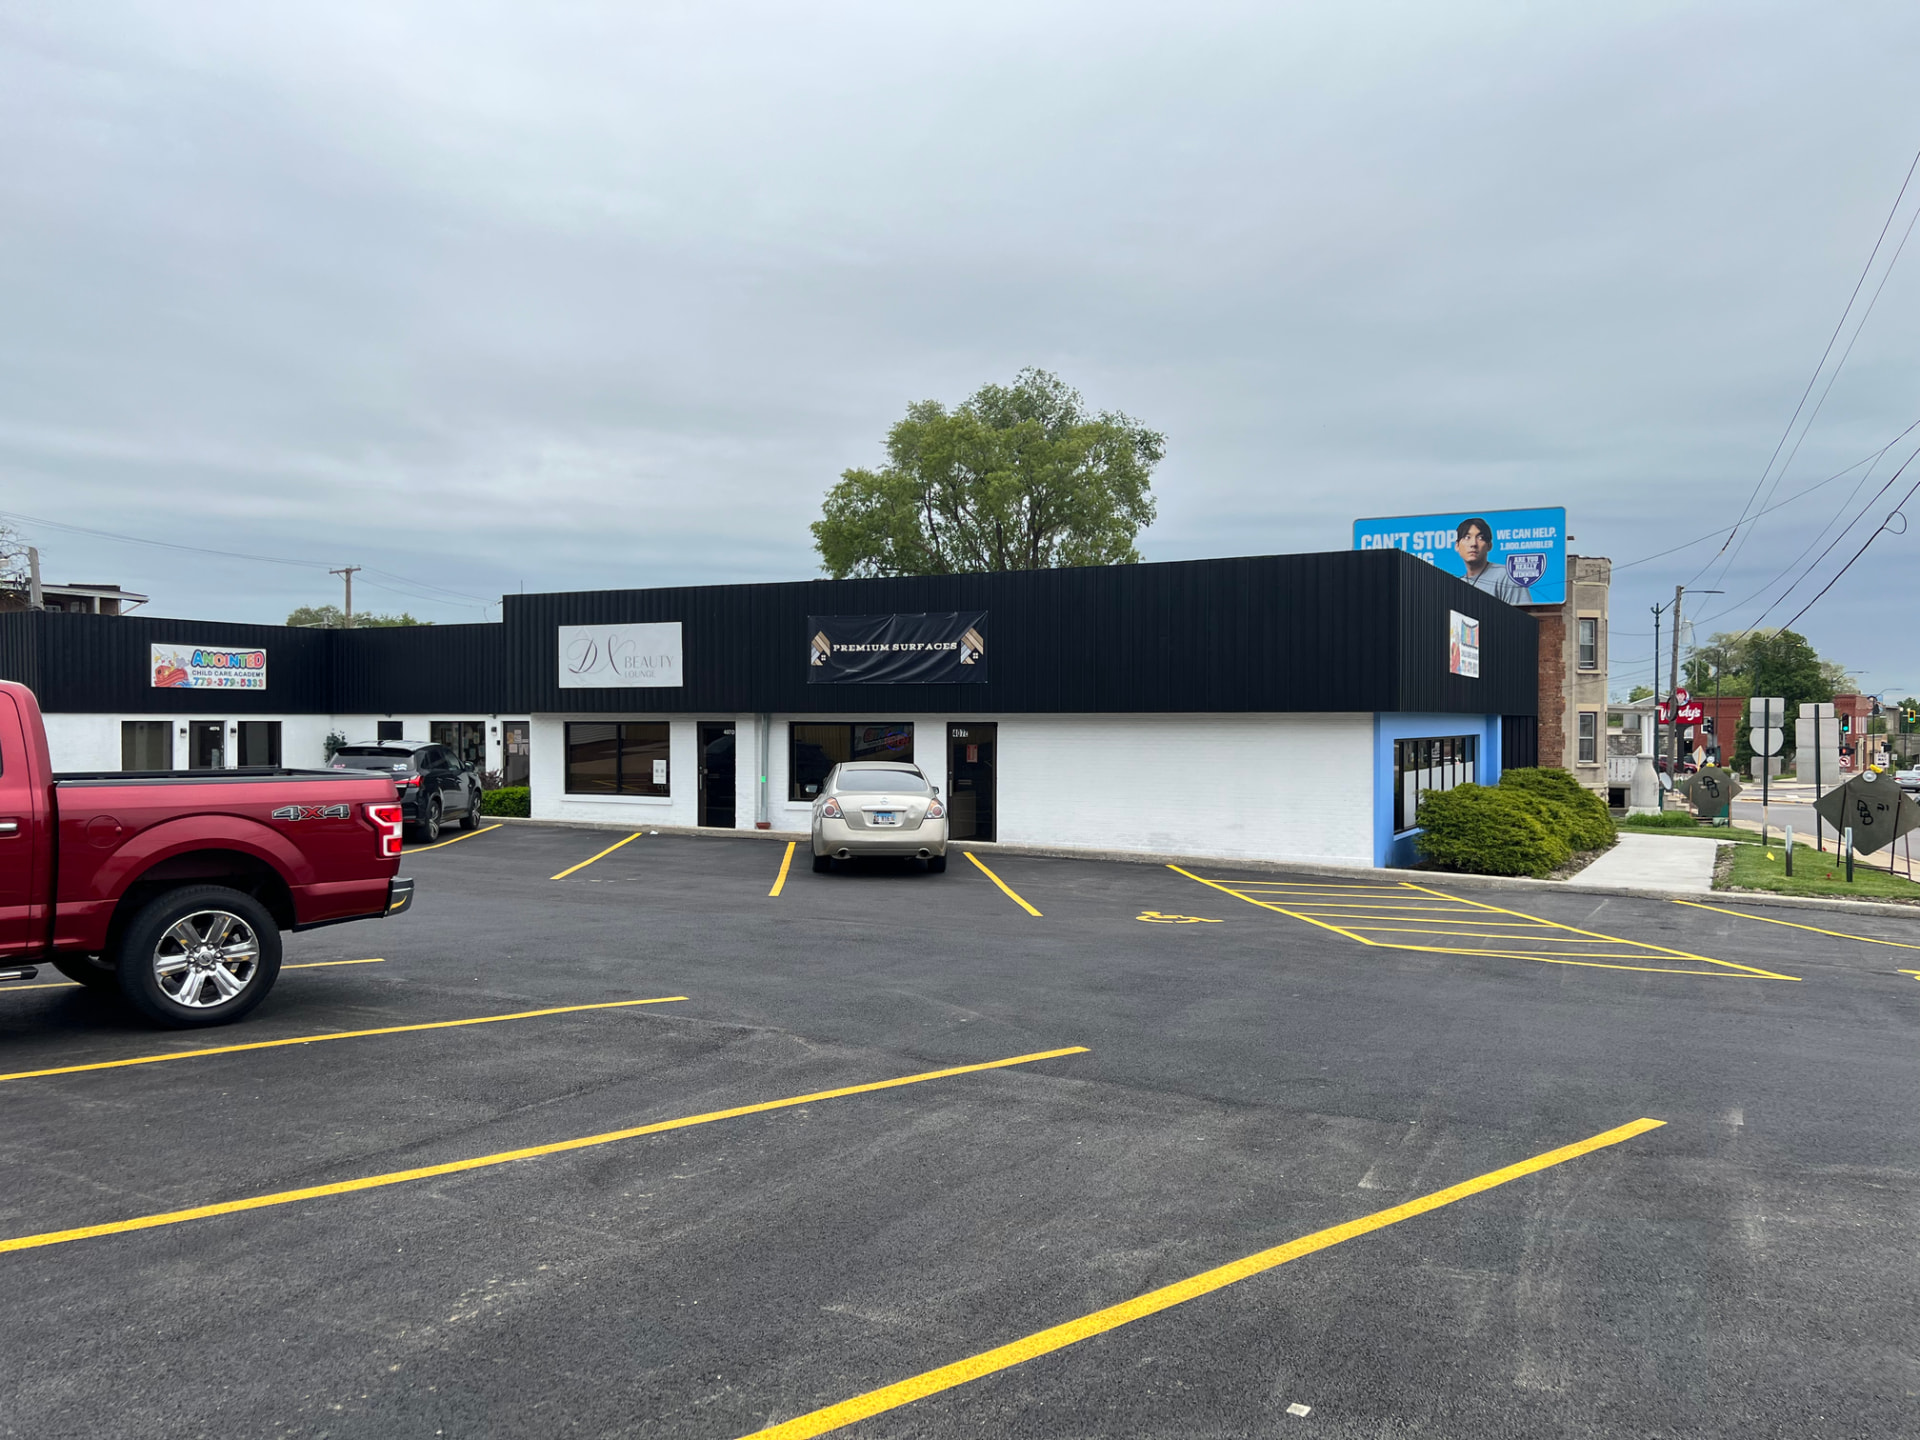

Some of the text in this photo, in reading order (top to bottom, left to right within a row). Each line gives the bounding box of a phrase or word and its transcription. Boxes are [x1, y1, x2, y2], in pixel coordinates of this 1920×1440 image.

[1496, 526, 1557, 540] WE CAN HELP.
[1361, 530, 1458, 551] CAN'T STOP
[833, 642, 958, 652] PREMIUM SURFACES
[191, 649, 265, 669] ANOINTED
[624, 655, 674, 669] BEAUTY
[624, 670, 656, 678] LOUNGE
